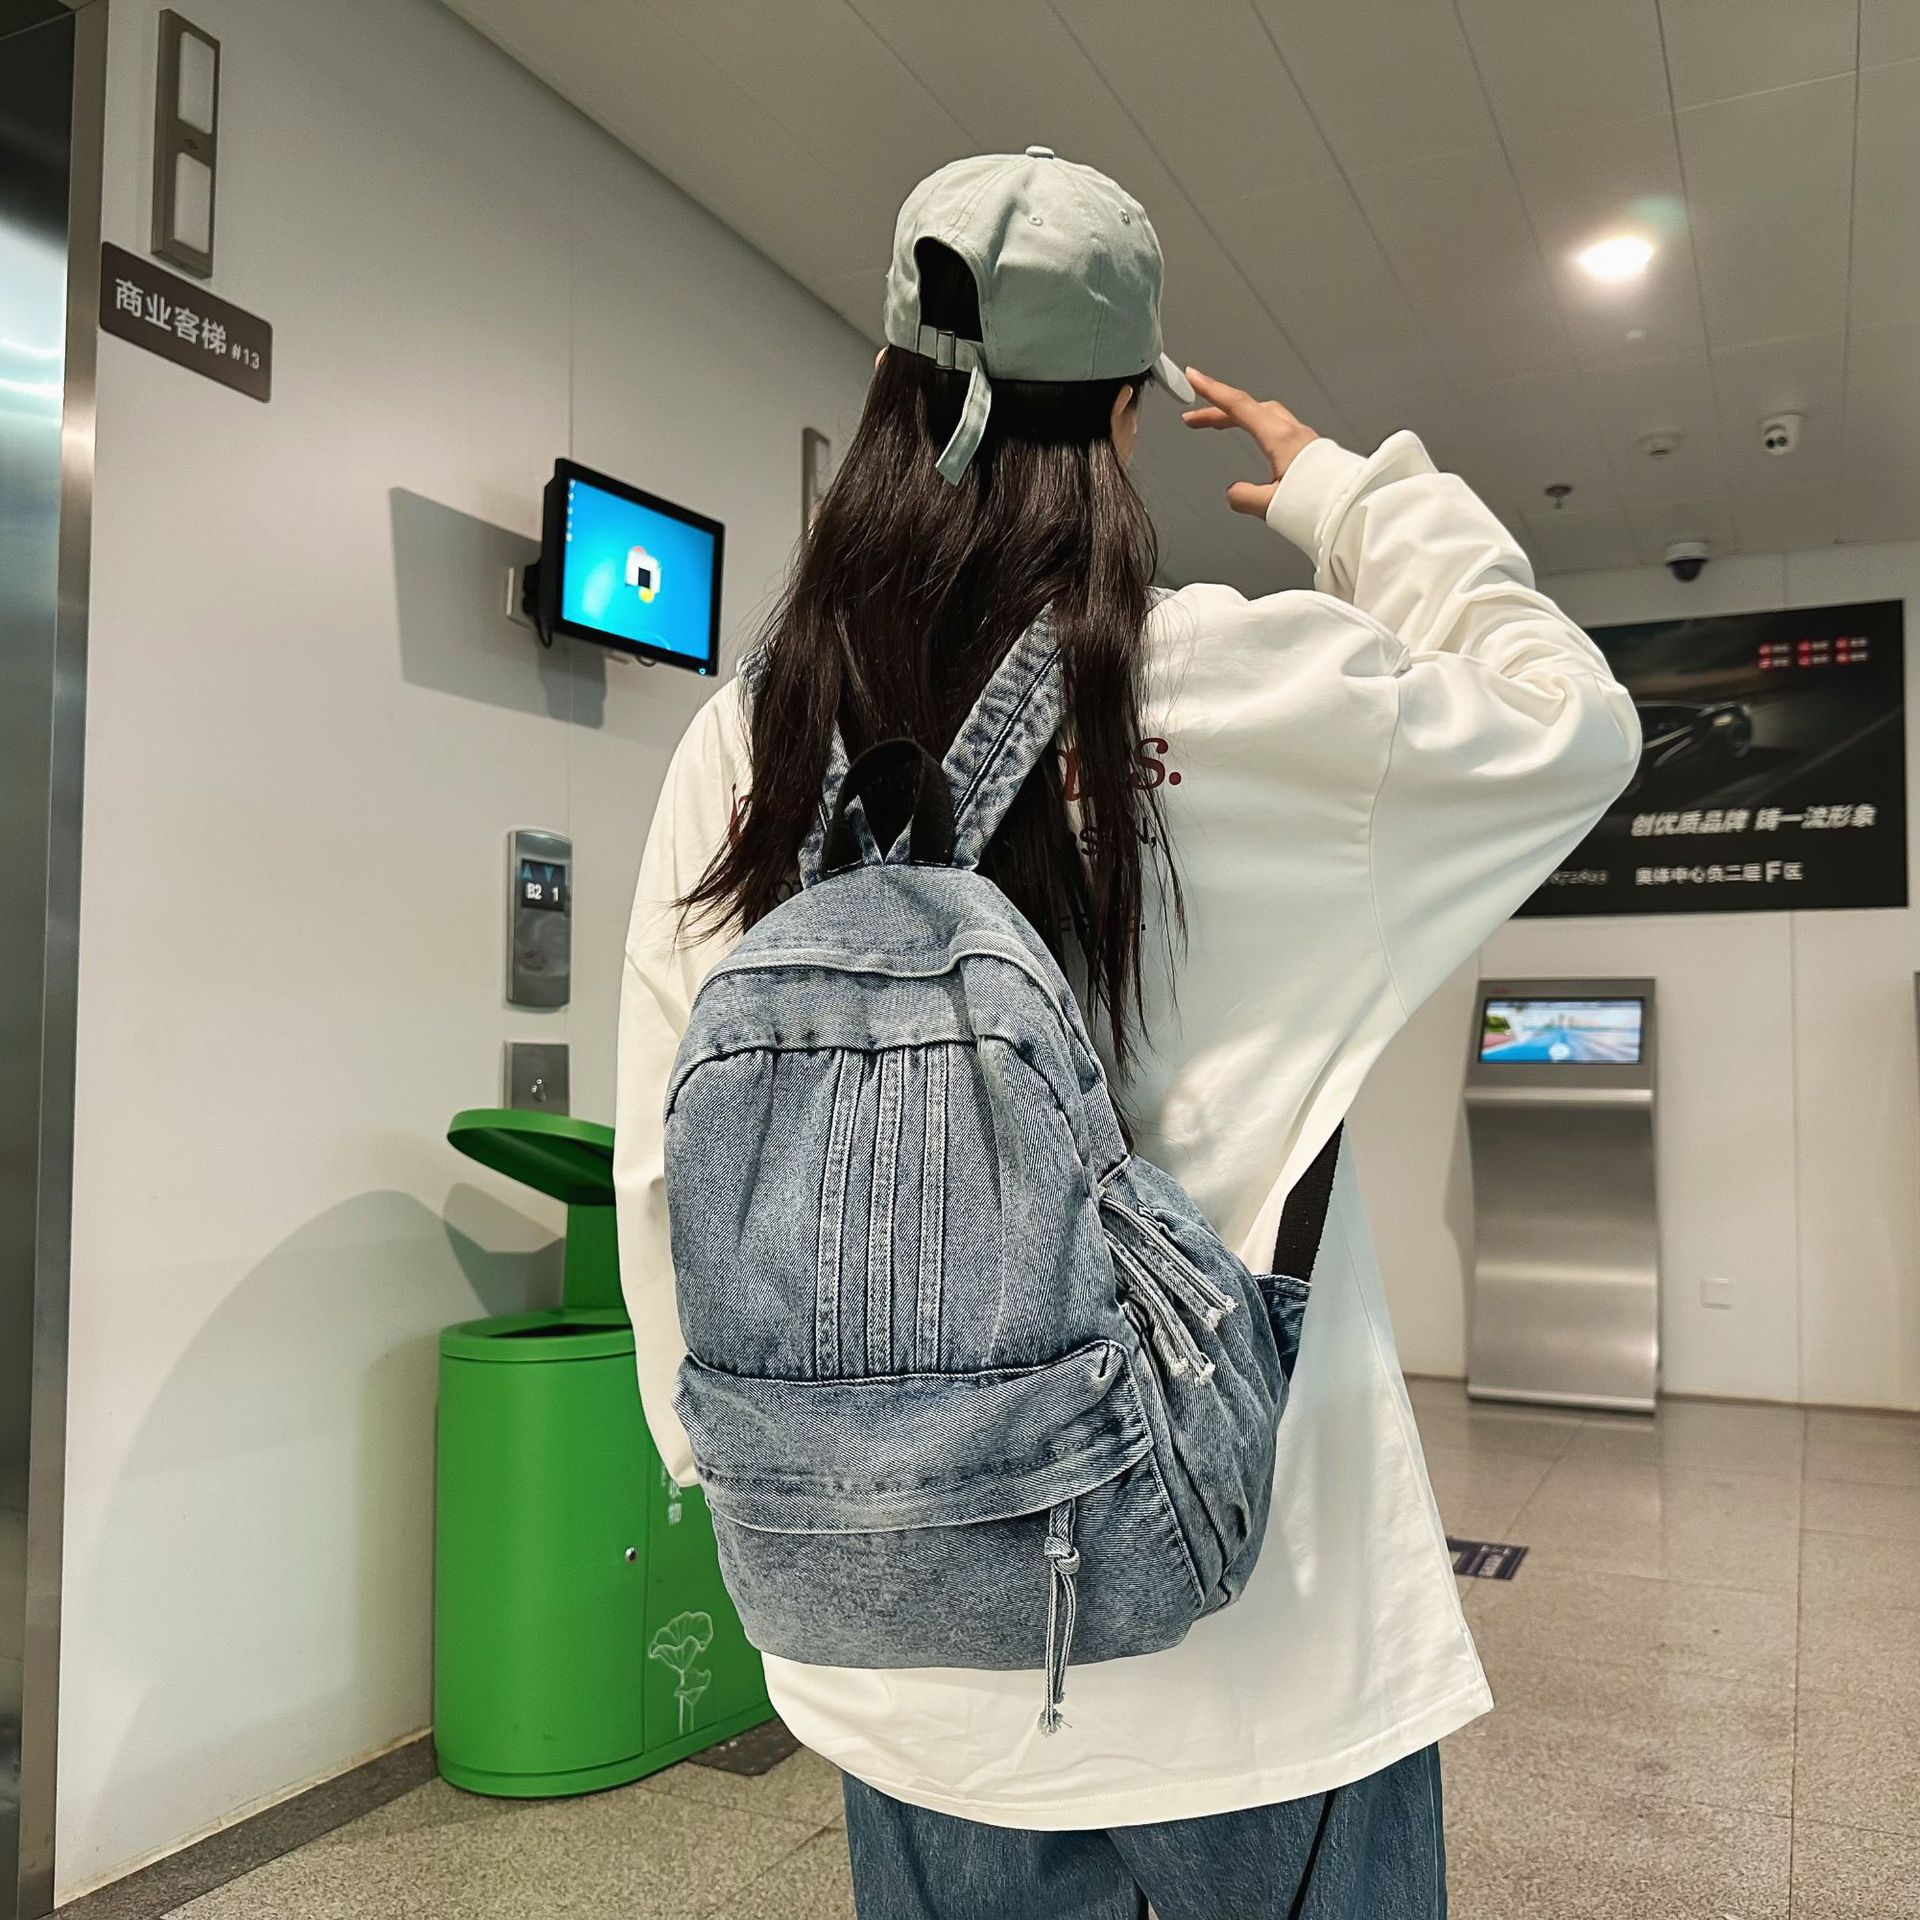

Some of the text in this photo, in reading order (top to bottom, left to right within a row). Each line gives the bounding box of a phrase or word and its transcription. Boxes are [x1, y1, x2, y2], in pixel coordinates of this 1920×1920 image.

[115, 278, 260, 370] 商业客梯 #13
[527, 882, 559, 902] B2 1
